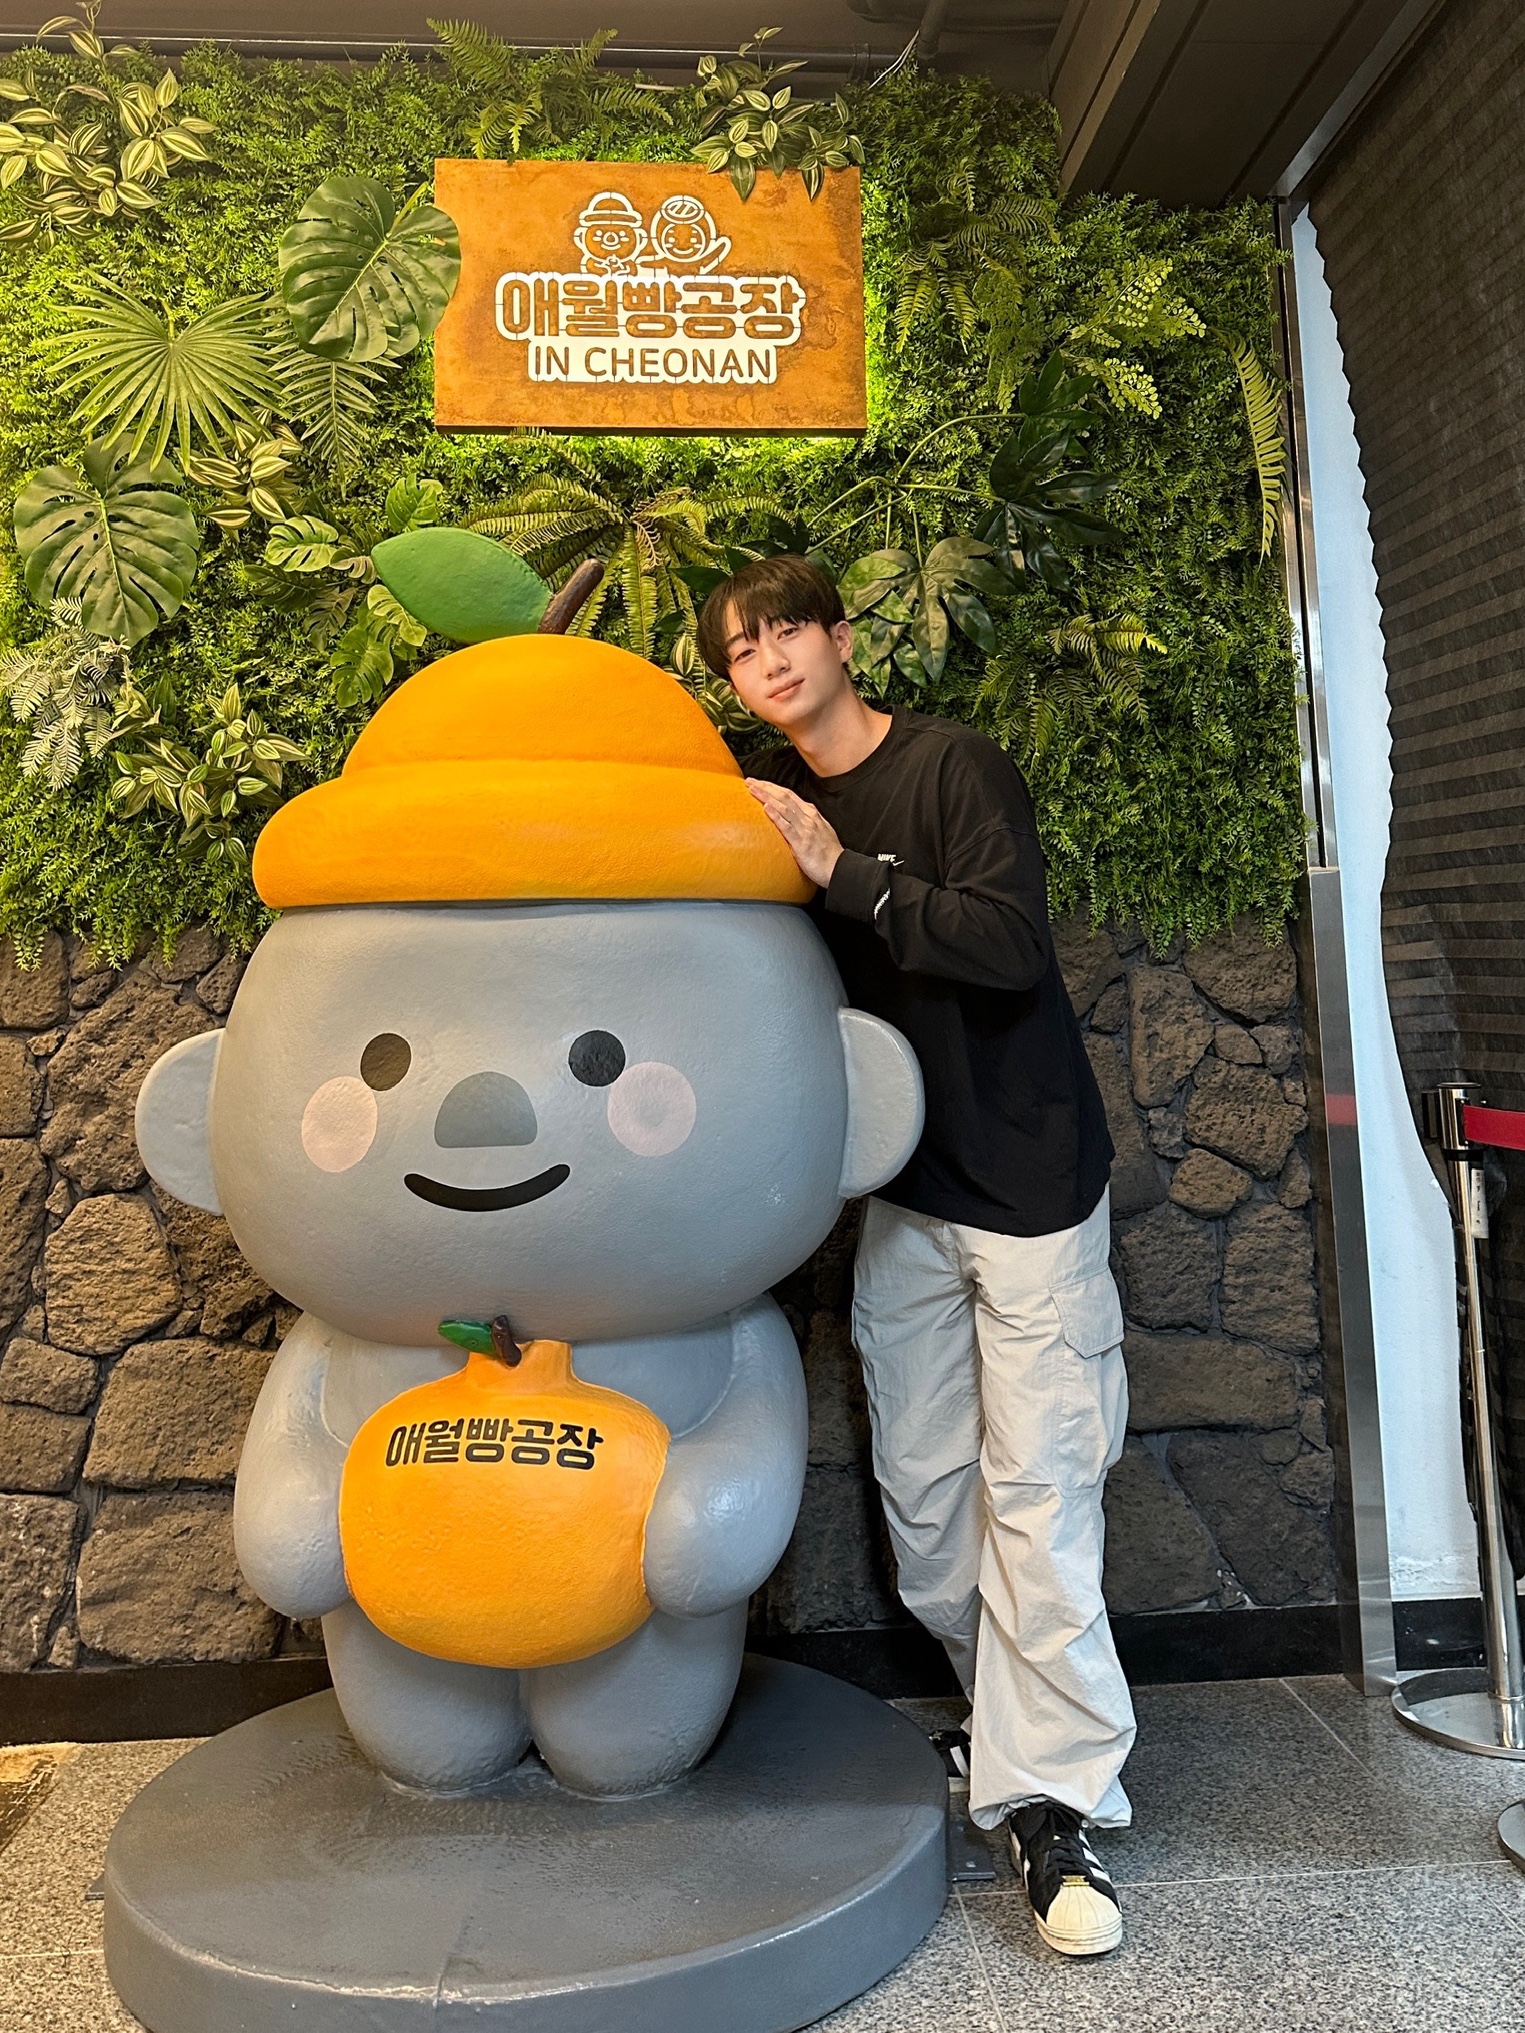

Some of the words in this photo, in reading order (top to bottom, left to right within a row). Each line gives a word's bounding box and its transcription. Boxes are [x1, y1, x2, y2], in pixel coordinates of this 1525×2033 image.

[501, 277, 801, 340] 애월빵공장
[534, 345, 570, 377] IN
[583, 345, 771, 379] CHEONAN
[385, 1417, 605, 1471] 애월빵공장
